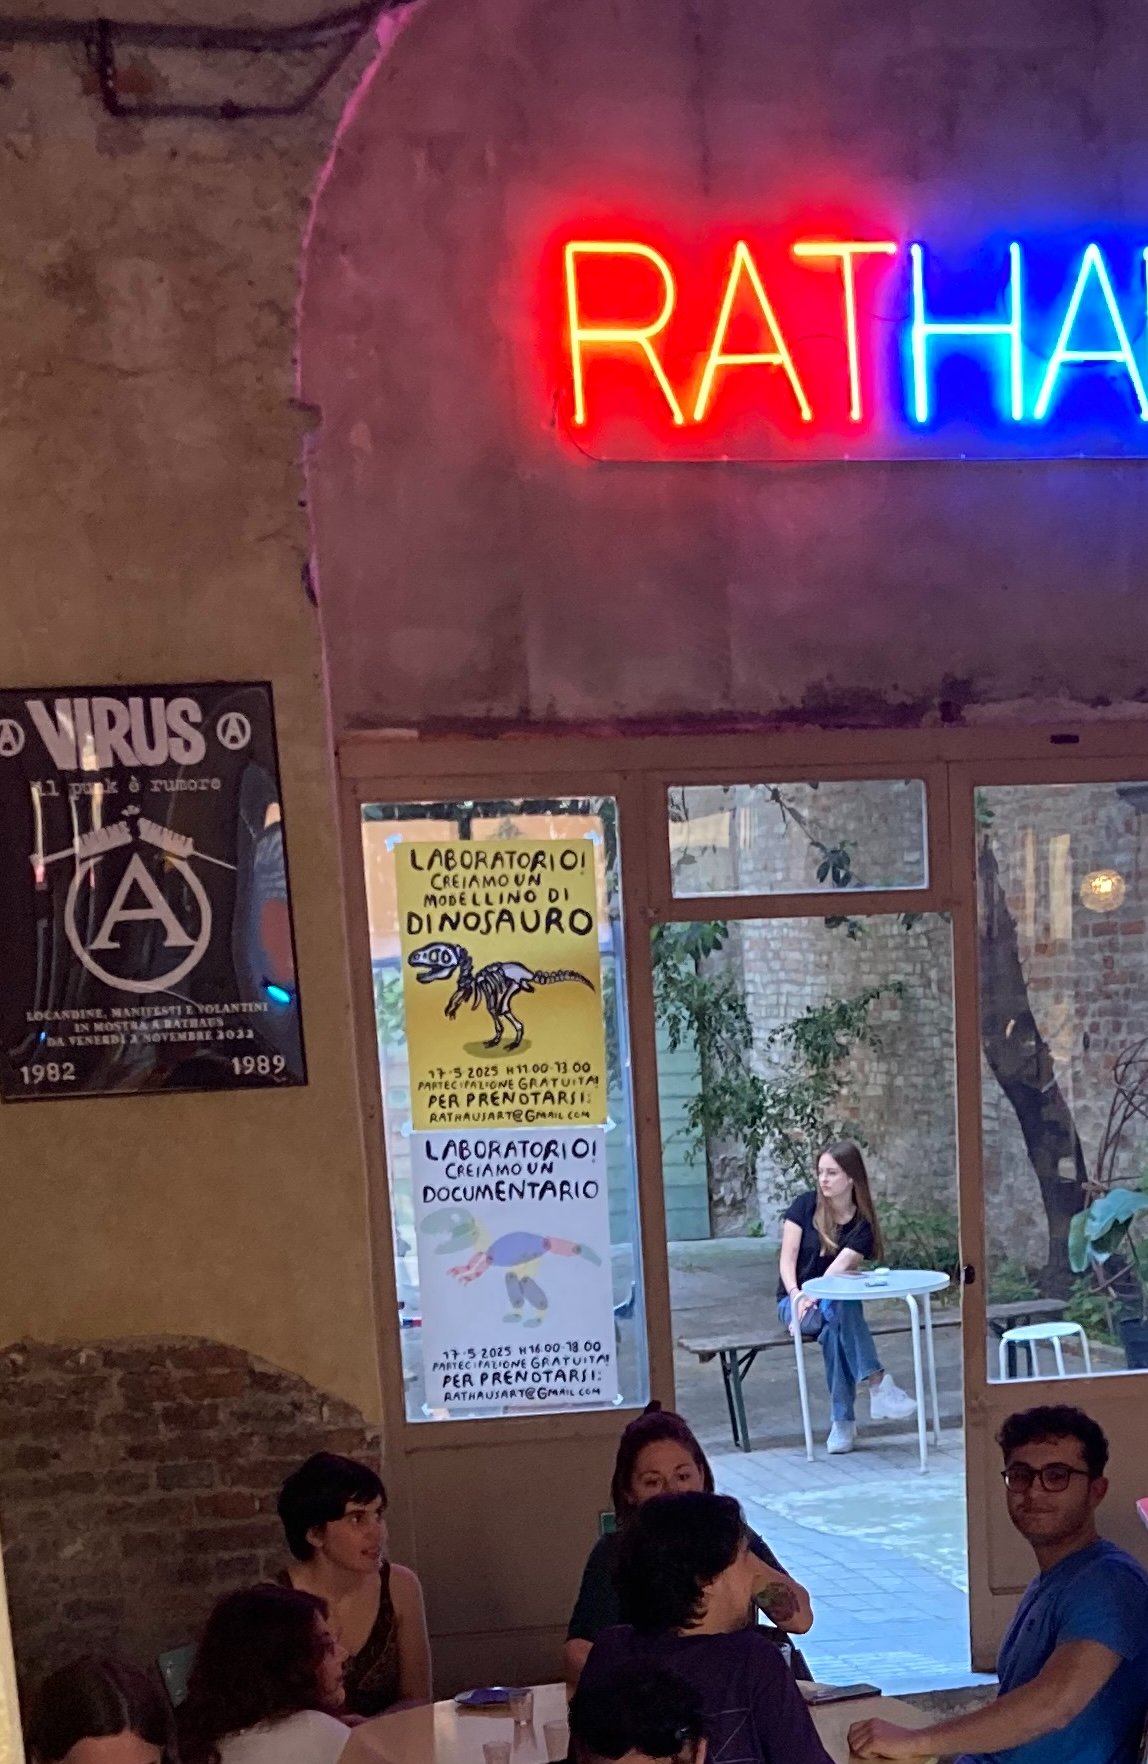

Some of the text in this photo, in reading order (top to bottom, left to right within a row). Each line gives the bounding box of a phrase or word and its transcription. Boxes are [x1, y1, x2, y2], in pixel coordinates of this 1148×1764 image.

[24, 697, 207, 771] VIRUS
[151, 777, 222, 793] rumore
[410, 848, 585, 875] LABORATORIO!
[430, 873, 541, 890] CREIAMO UN
[424, 887, 569, 908] MODELLINO DI
[407, 907, 593, 935] DINOSAURO
[74, 1022, 91, 1033] IN
[94, 1020, 148, 1033] MOSTRA
[165, 1016, 224, 1031] RATHAUS
[143, 1030, 213, 1043] NOVEMBRE
[20, 1062, 76, 1085] 1982
[231, 1055, 286, 1075] 1989
[418, 1075, 599, 1091] PARTECIPAZIONE GRATUITA!
[428, 1093, 460, 1109] PER
[425, 1138, 596, 1163] LABORATORIO!
[445, 1161, 554, 1179] CREIAMO UN
[422, 1179, 599, 1203] DOCUMENTARIO
[432, 1354, 610, 1371] PARTECIPAZIONE GRATUITA!
[442, 1373, 474, 1388] PER
